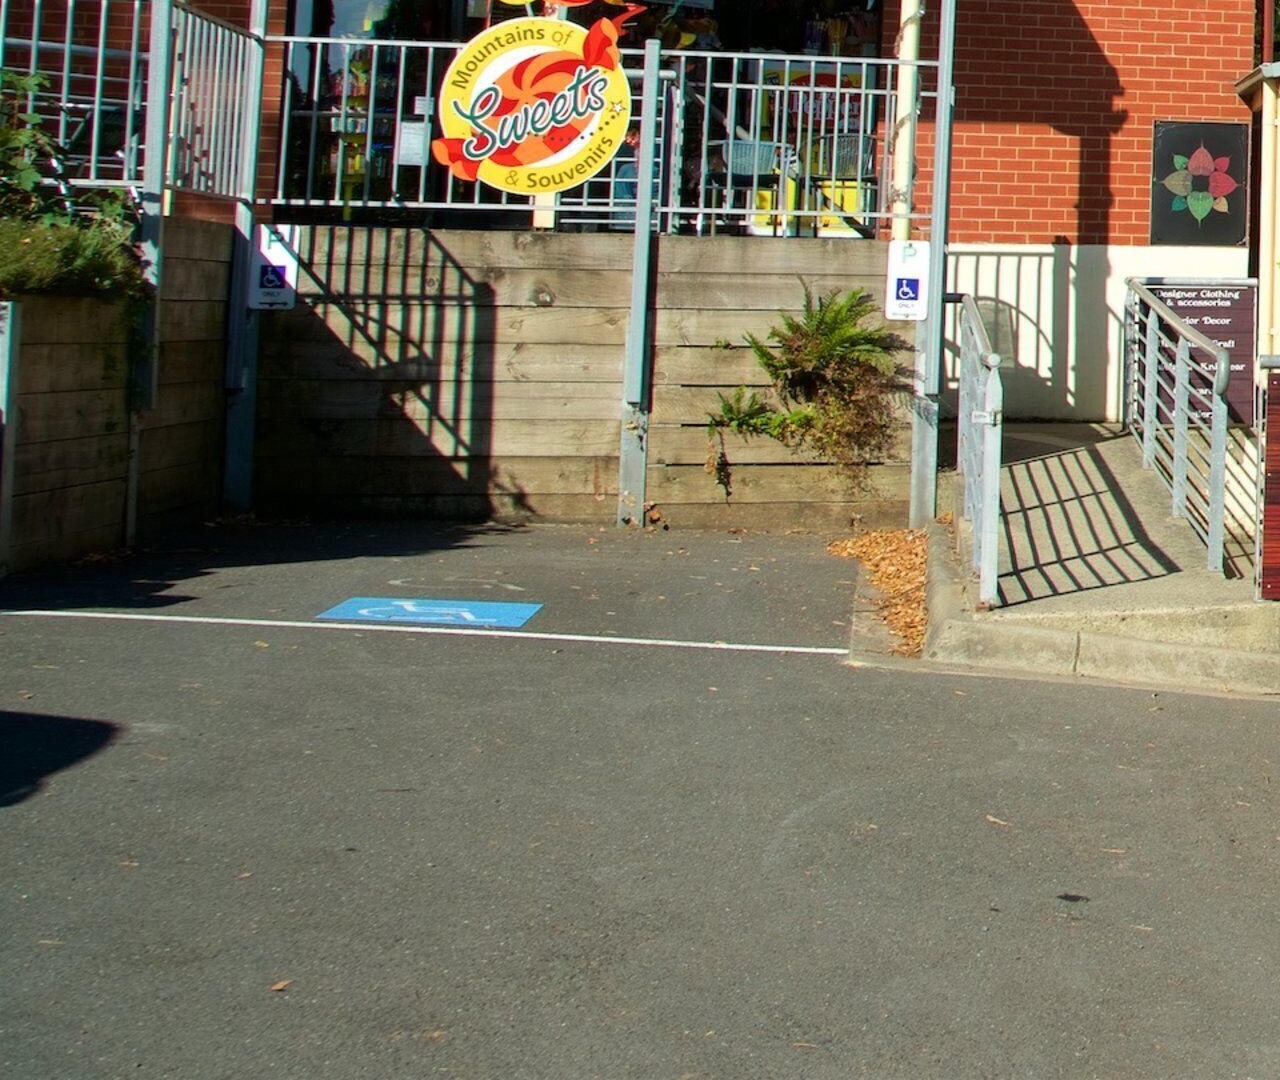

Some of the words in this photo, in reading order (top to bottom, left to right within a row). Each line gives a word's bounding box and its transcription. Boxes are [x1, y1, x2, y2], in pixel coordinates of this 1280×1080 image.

[451, 26, 545, 89] Mountains
[552, 30, 575, 46] of
[453, 66, 608, 159] Sweets
[504, 169, 520, 186] &
[526, 135, 613, 189] Souvenirs
[1156, 289, 1197, 299] Designer
[1200, 289, 1240, 299] Clothing
[1166, 299, 1174, 307] &
[1177, 298, 1231, 307] accessories
[1201, 315, 1232, 325] Decor
